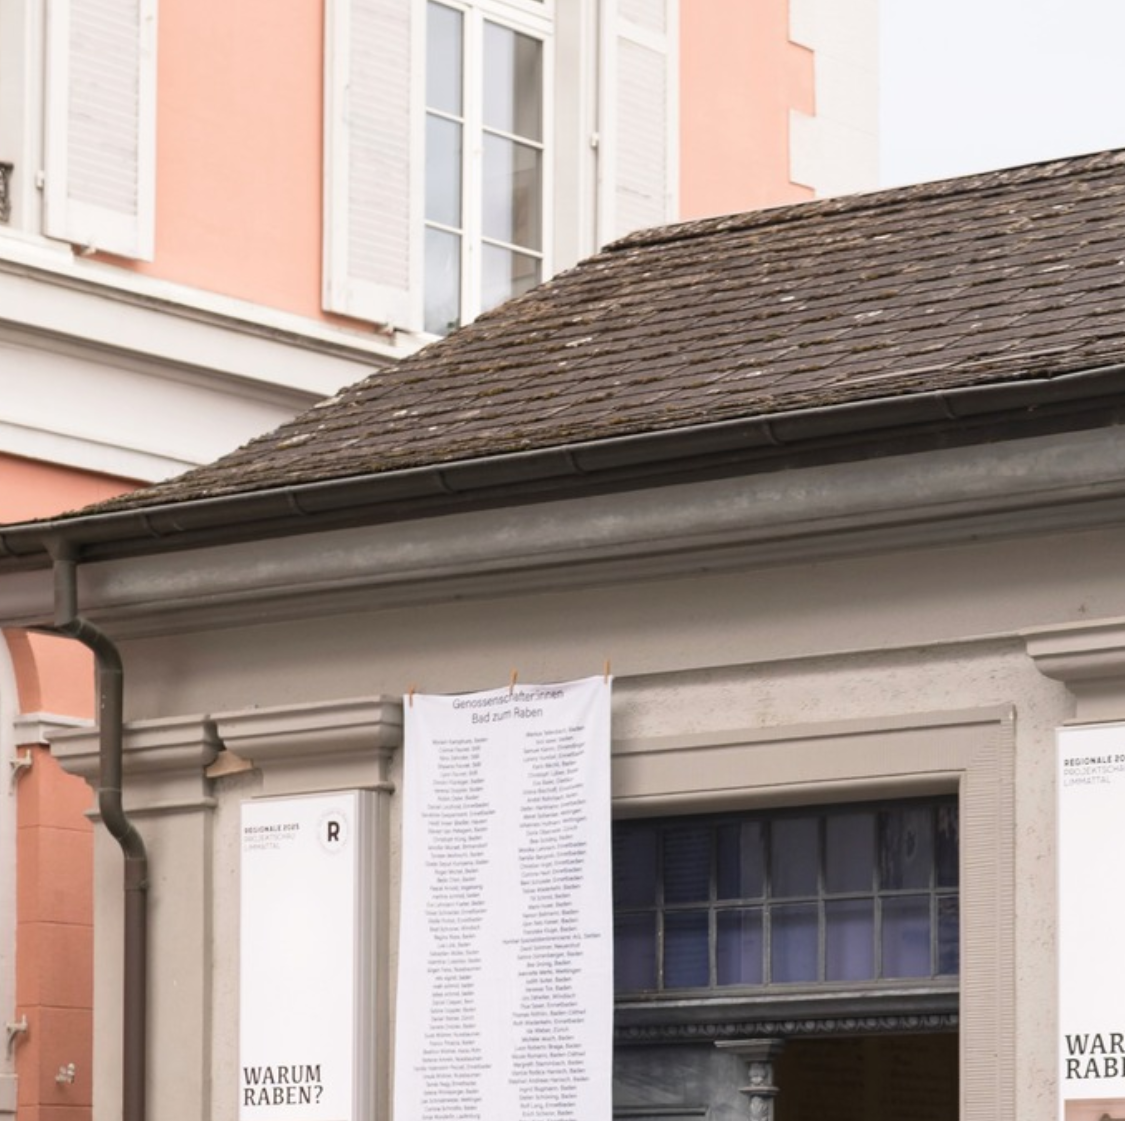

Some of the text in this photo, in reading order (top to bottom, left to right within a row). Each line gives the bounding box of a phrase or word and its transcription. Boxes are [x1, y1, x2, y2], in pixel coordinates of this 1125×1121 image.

[472, 707, 543, 724] Bad zum Raben
[1064, 755, 1112, 766] REGIONALE
[327, 820, 340, 842] R
[243, 1064, 321, 1086] WARUM
[244, 1084, 324, 1106] RABEN?
